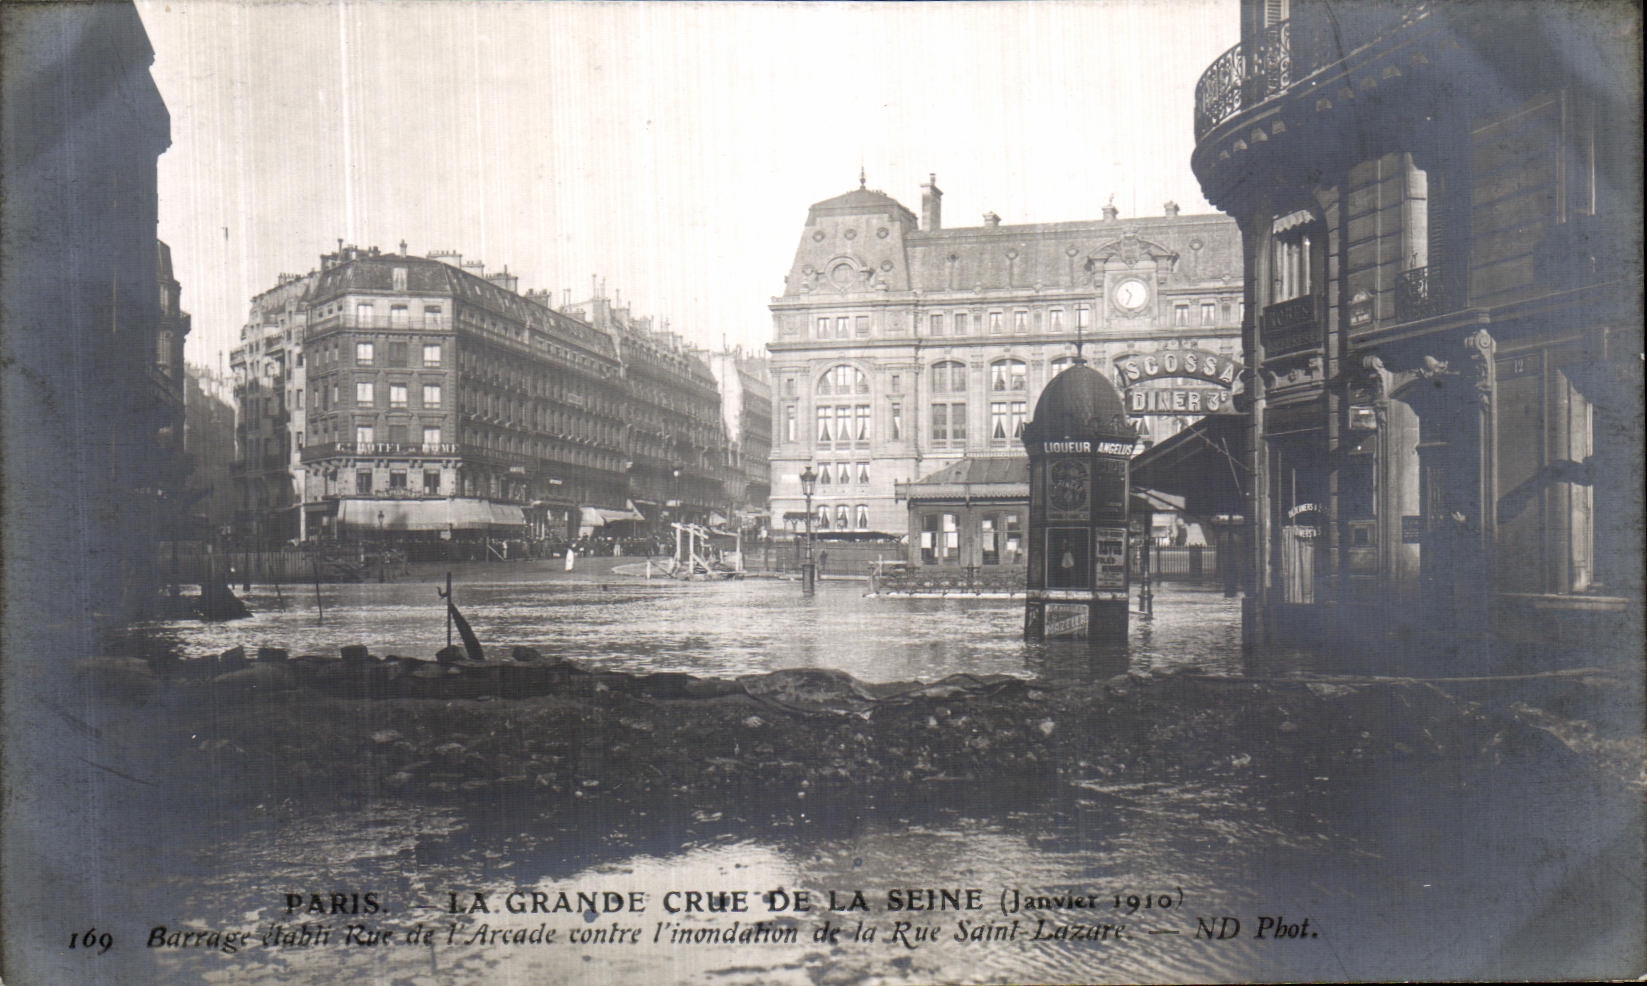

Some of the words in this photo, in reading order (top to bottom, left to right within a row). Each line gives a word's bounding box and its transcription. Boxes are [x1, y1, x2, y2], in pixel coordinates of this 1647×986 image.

[1125, 353, 1234, 383] SCOSSA
[1132, 391, 1201, 411] DINER
[1043, 441, 1091, 454] LIQUEUR
[1097, 441, 1134, 455] ANGELUS
